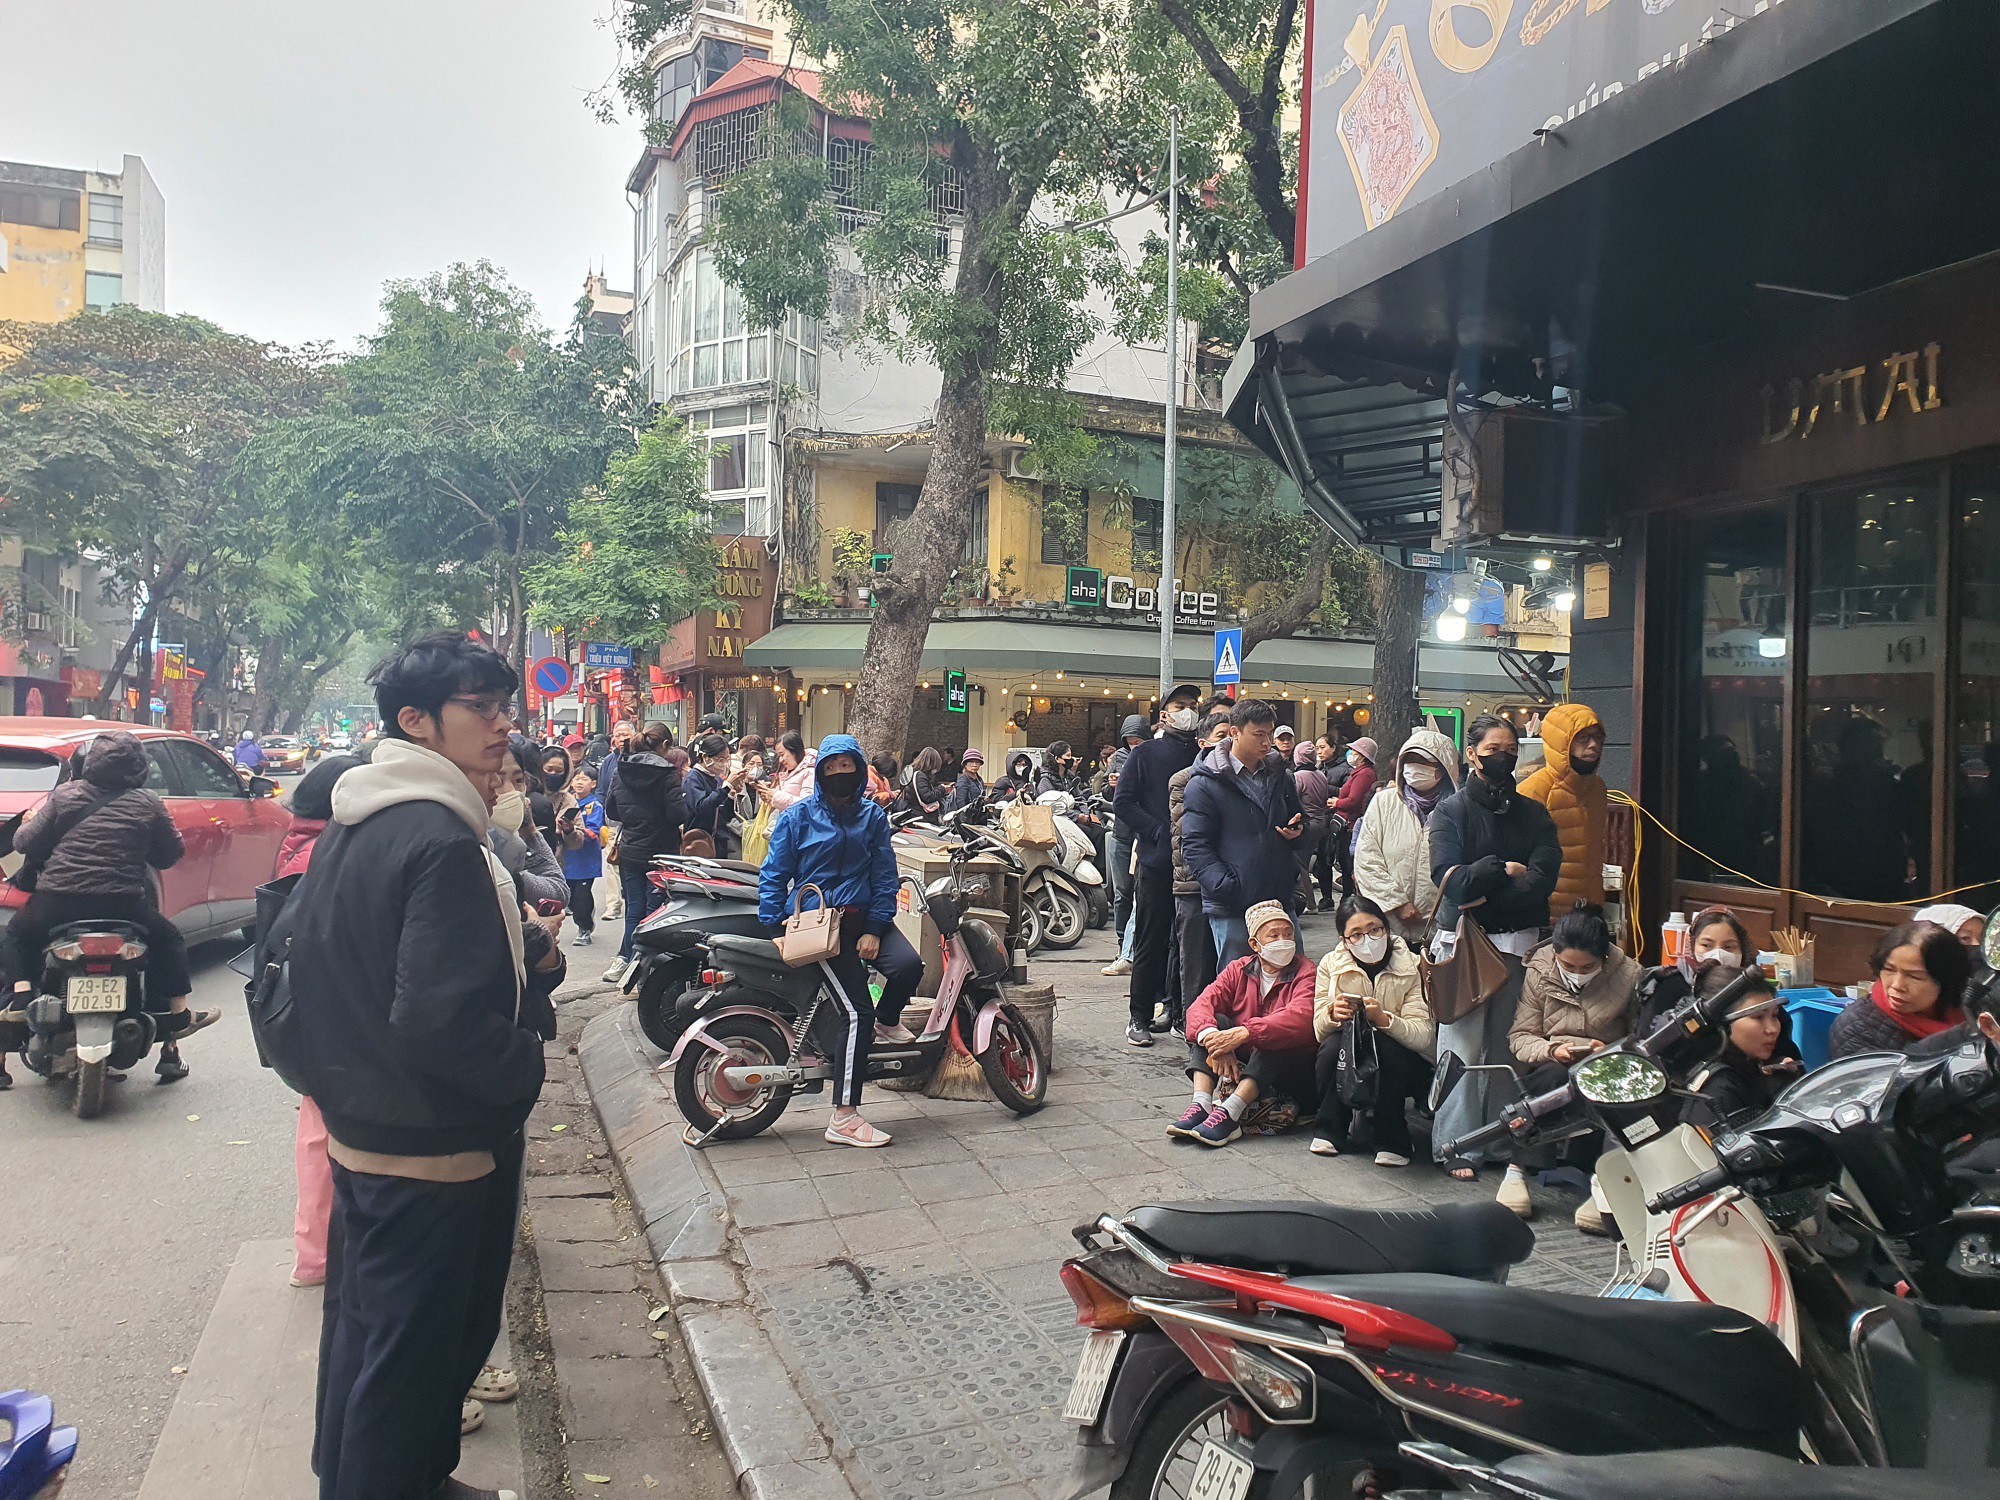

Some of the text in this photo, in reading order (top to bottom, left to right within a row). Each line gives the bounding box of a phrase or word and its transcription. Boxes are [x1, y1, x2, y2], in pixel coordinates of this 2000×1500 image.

[1071, 580, 1096, 598] aha
[1174, 615, 1198, 626] Coffee
[1199, 617, 1216, 626] farm
[707, 635, 751, 658] NAM
[950, 684, 964, 701] aha
[77, 979, 118, 994] 29-E2
[72, 995, 121, 1010] 702.91
[1066, 1380, 1104, 1418] 308.98
